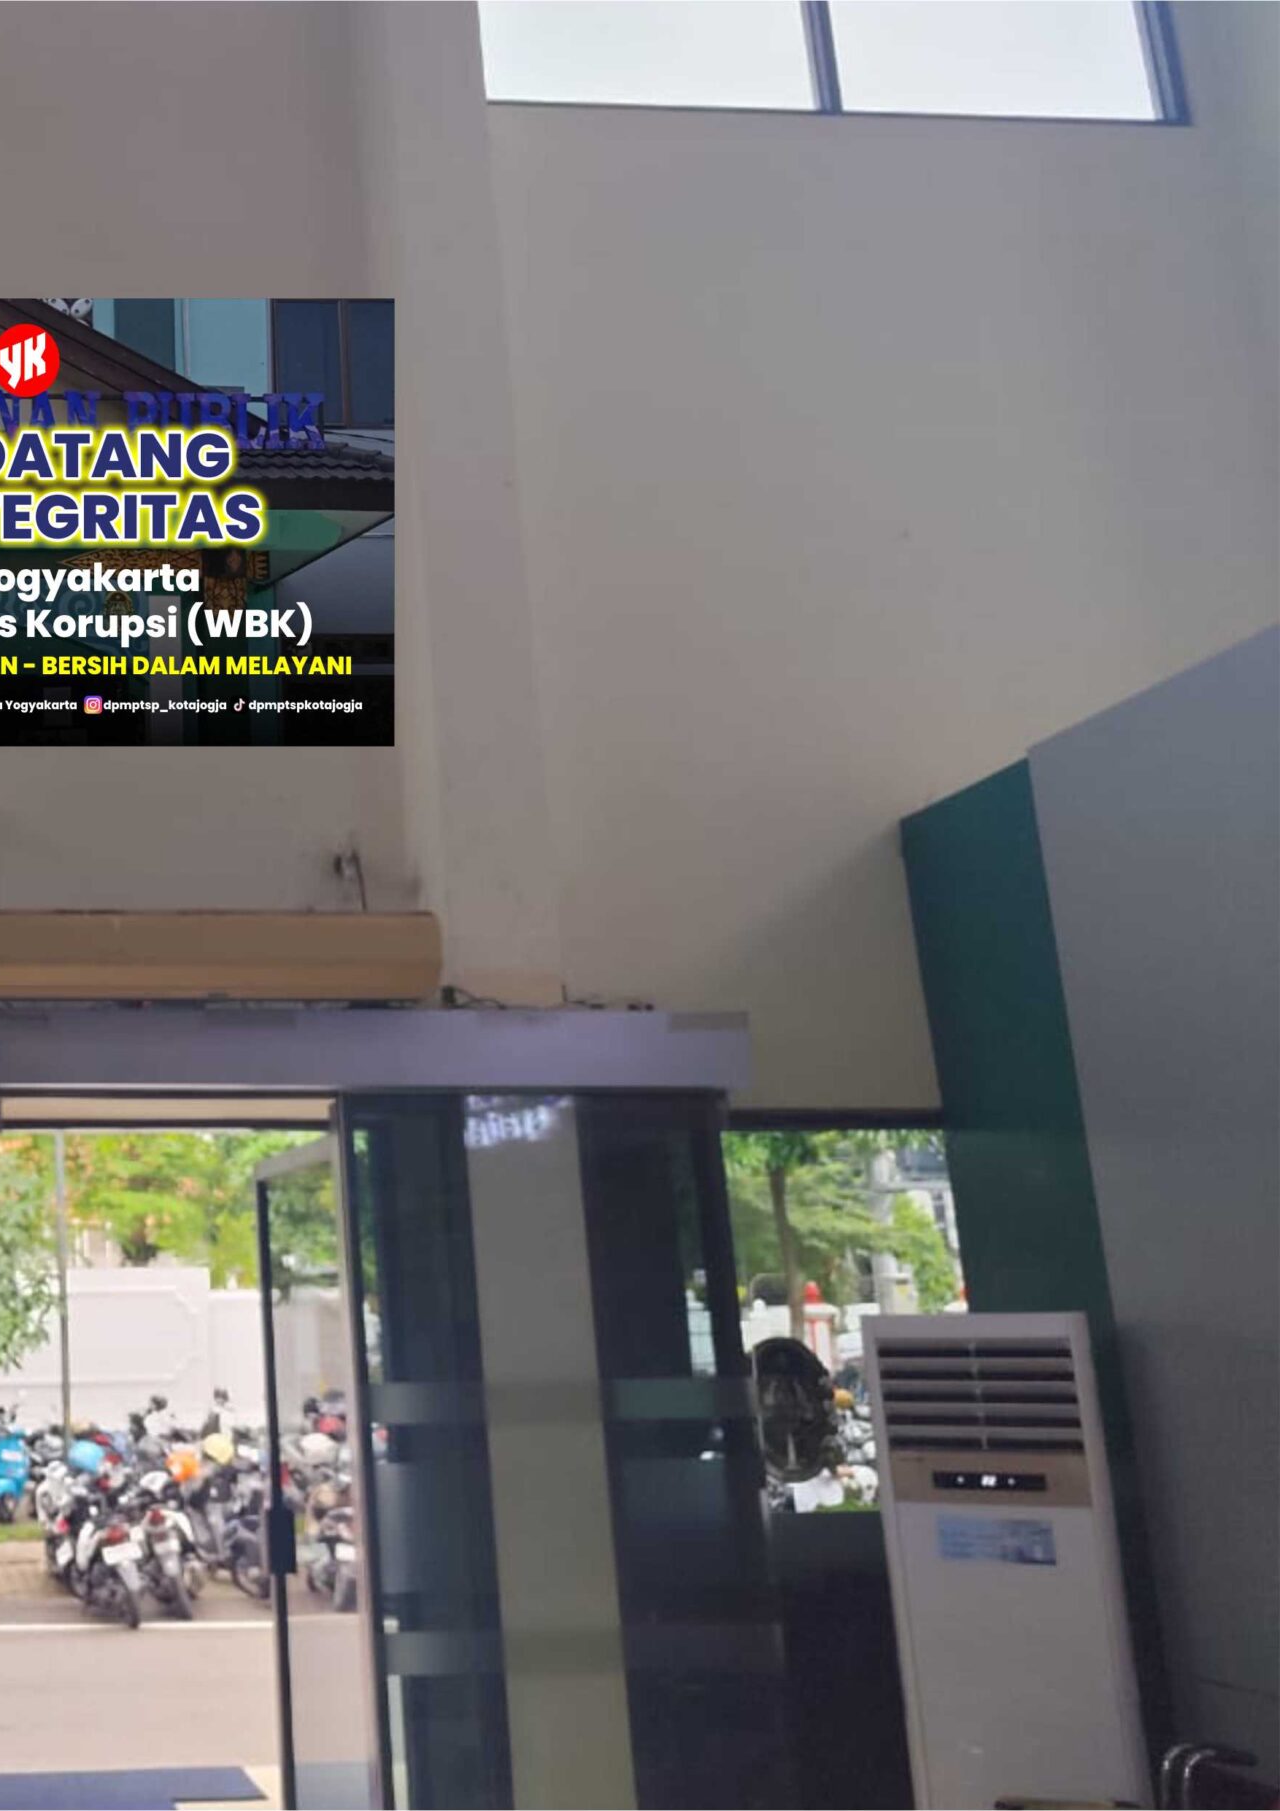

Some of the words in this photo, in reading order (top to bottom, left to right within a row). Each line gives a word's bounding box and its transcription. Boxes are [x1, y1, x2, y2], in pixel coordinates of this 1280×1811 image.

[24, 605, 178, 648] Korupsi
[187, 602, 313, 646] (WBK)
[42, 655, 127, 675] BERSIH
[132, 656, 220, 675] DALAM
[226, 656, 352, 675] MELAYANI
[5, 699, 78, 713] Yogyakarta
[103, 699, 227, 713] dpmptsp_kotajogja
[248, 699, 363, 713] dpmptspkotajogja
